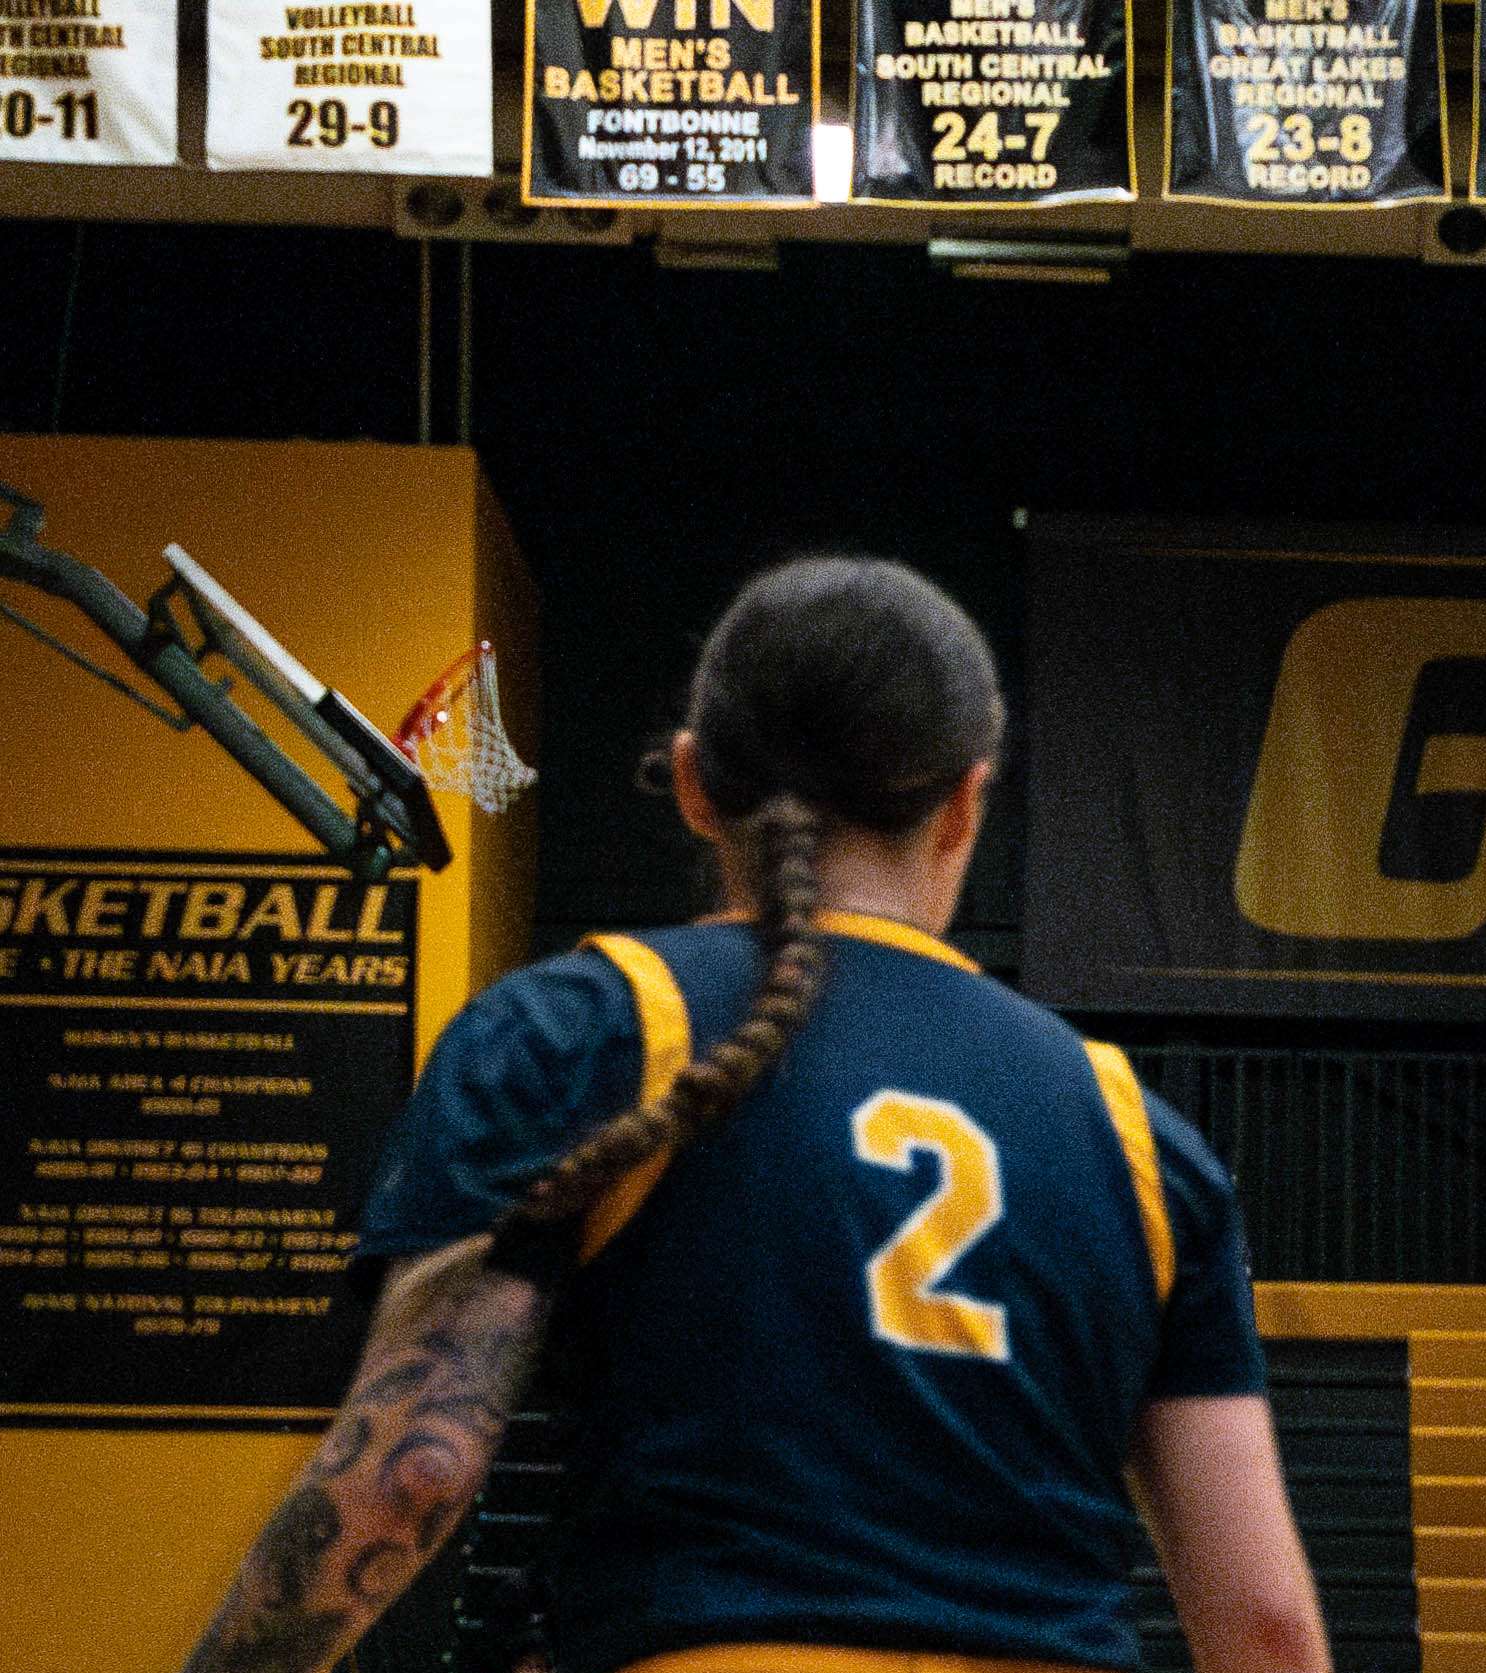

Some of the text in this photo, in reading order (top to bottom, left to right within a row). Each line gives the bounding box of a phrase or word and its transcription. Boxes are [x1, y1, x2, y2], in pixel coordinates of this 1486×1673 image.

[286, 5, 415, 30] VOLLEYBALL
[30, 25, 126, 49] CENTRAL
[260, 34, 442, 59] SOUTH CENTRAL
[905, 21, 1086, 47] BASKETBALL
[1218, 25, 1398, 50] BASKETBALL
[610, 36, 731, 69] MEN'S
[877, 53, 1111, 78] SOUTH CENTRAL
[0, 54, 91, 80] EGIONAL
[294, 63, 405, 88] REGIONAL
[1209, 56, 1404, 82] GREAT LAKES
[544, 68, 800, 106] BASKETBALL
[922, 81, 1070, 107] REGIONAL
[1235, 84, 1383, 109] REGIONAL
[0, 91, 98, 139] 0-11
[287, 99, 400, 149] 29-9
[586, 109, 760, 136] FONTBONNE
[933, 112, 1060, 161] 24-7
[1247, 114, 1372, 163] 23-8
[579, 138, 769, 163] November 12, 2011
[618, 165, 658, 190] 69
[686, 166, 726, 192] 55
[935, 163, 1058, 189] RECORD
[1248, 165, 1371, 190] RECORD
[62, 948, 408, 987] THE NAIA YEARS
[850, 1089, 1010, 1362] 2
